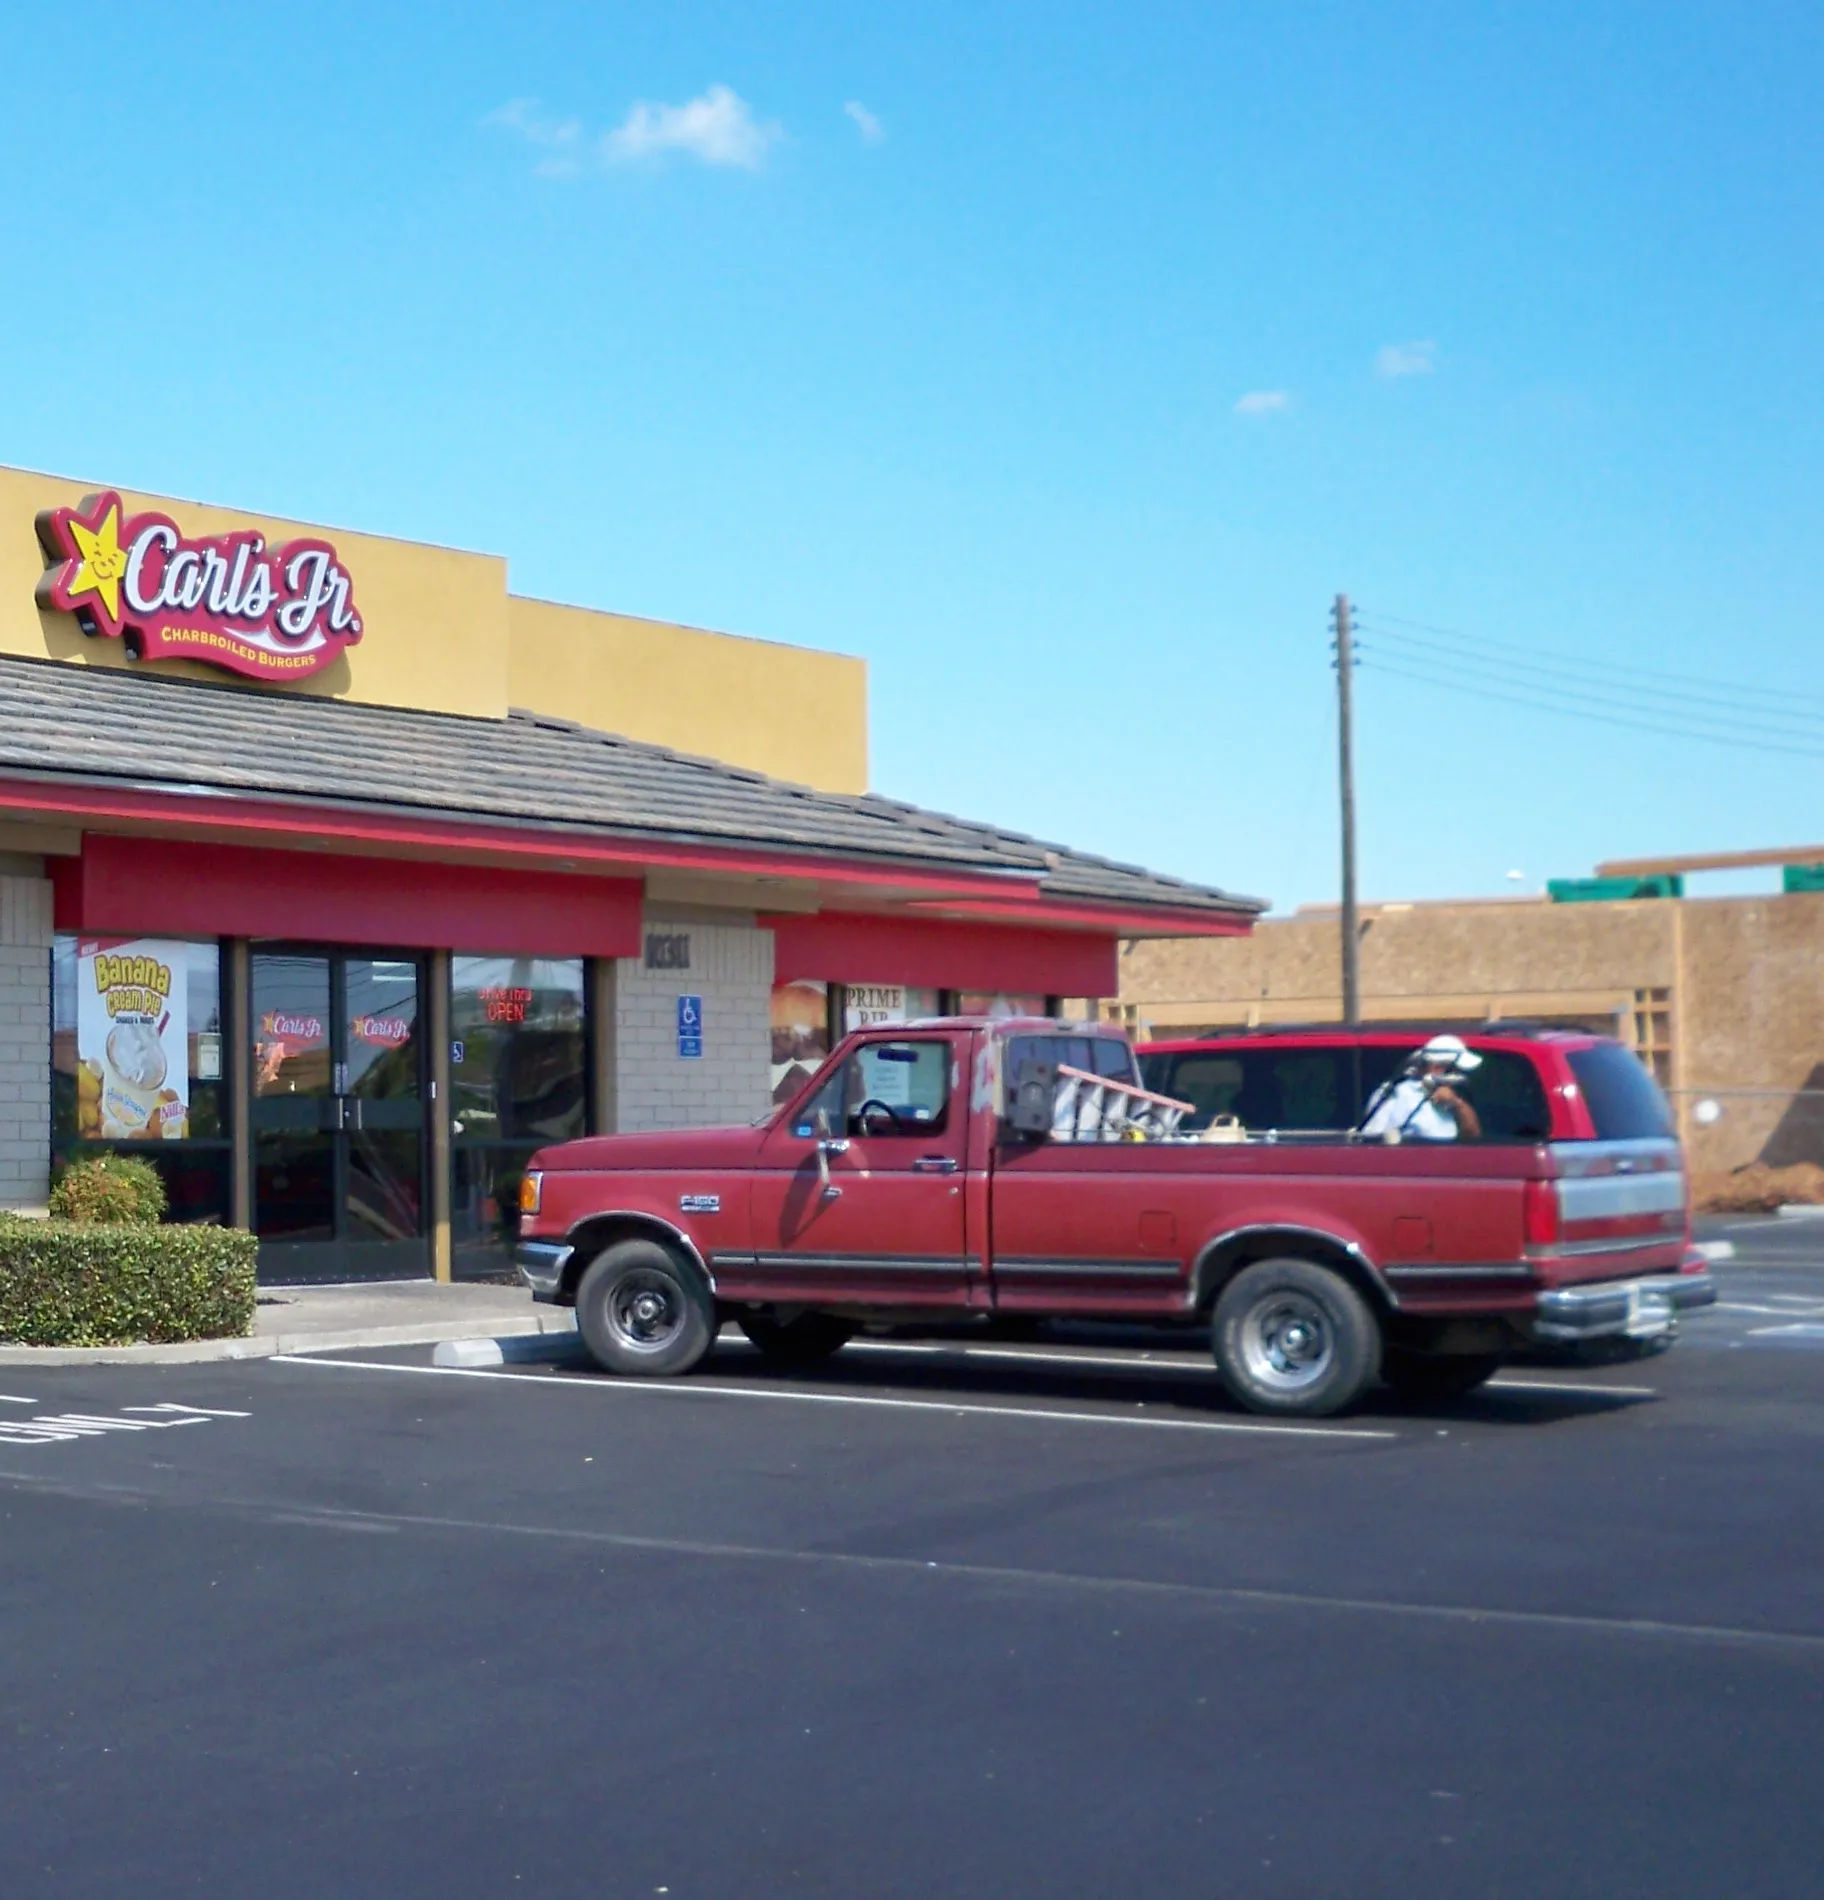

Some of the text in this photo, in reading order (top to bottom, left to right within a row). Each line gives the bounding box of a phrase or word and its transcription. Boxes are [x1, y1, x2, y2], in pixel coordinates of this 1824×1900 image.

[124, 524, 362, 636] Carl's Jr.
[161, 626, 317, 669] CHARBROILED BURGERS
[94, 954, 171, 998] Banana
[846, 987, 902, 1008] PRIME
[488, 1002, 524, 1022] OPEN
